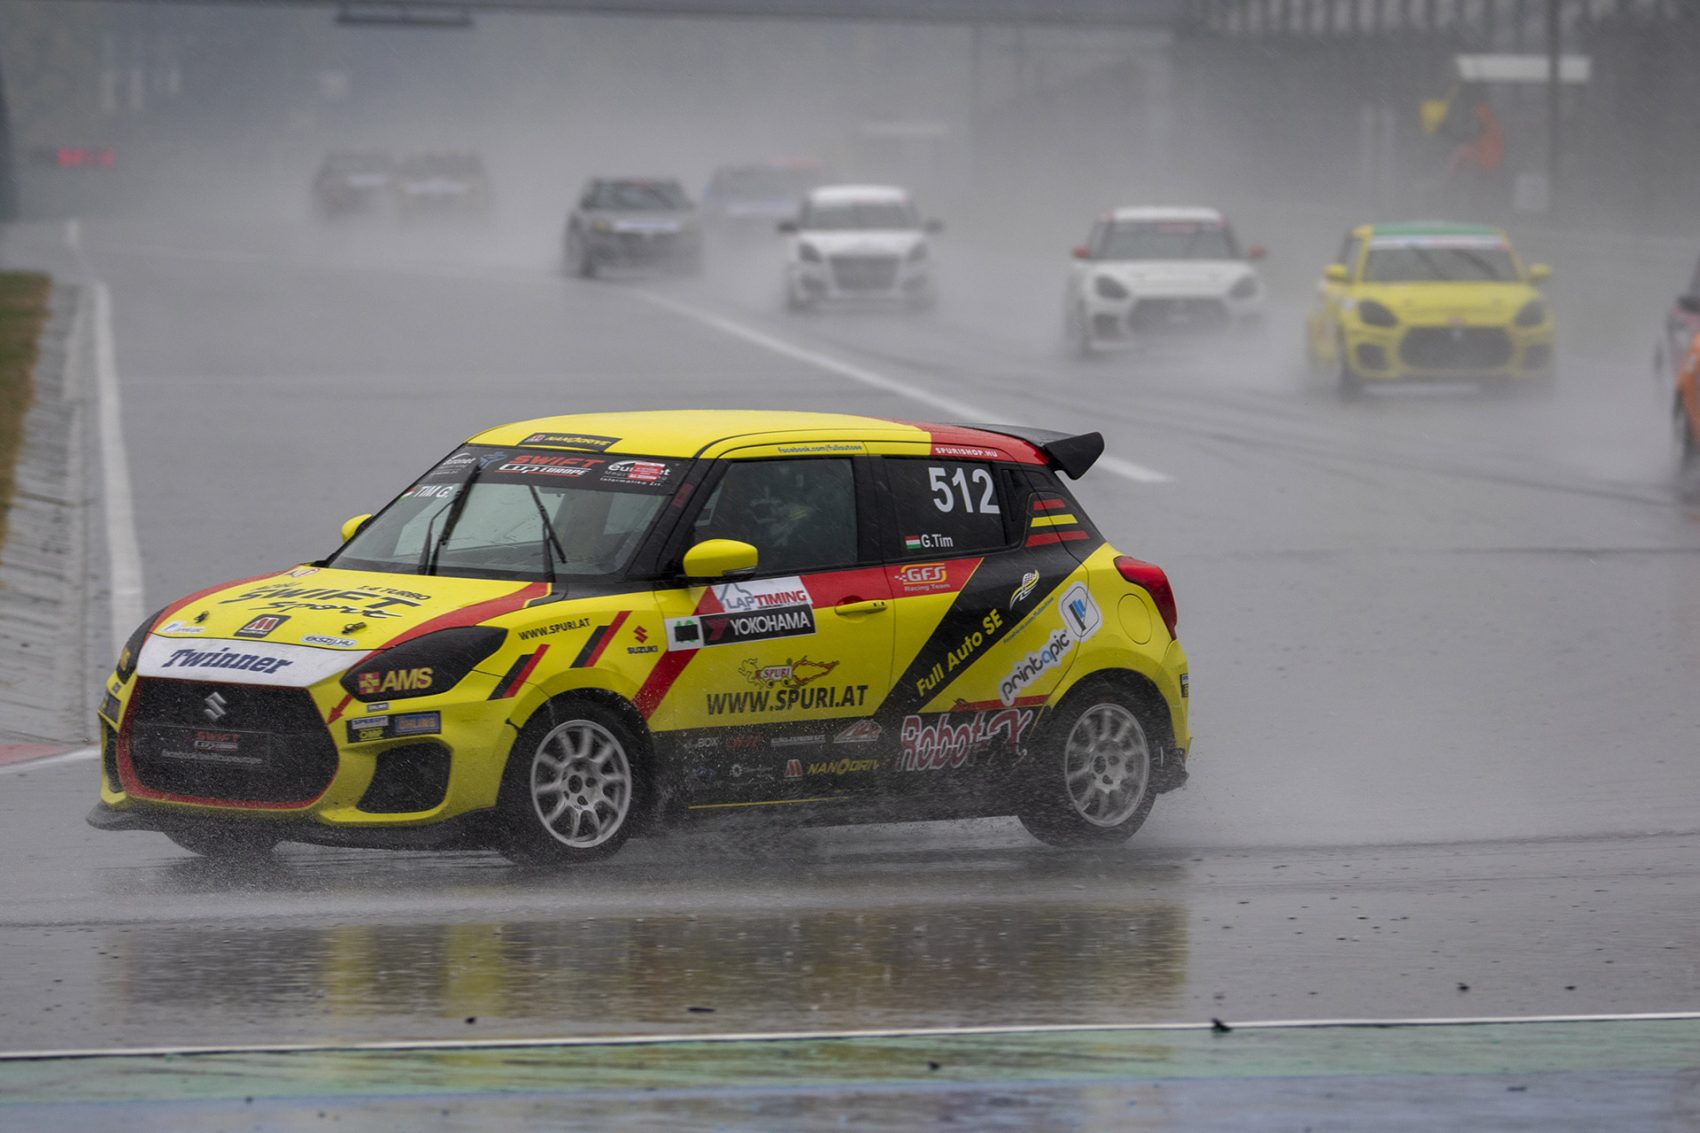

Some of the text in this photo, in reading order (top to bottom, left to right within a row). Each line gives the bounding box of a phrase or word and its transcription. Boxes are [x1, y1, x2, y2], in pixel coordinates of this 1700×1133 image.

[507, 455, 605, 468] SWIFT
[928, 467, 1001, 514] 512
[921, 534, 954, 549] G.Tim
[906, 566, 946, 583] GFS
[219, 588, 422, 609] SWIFT
[518, 618, 590, 641] WWW.SPURI.AT
[730, 611, 811, 636] YOKOHAMA
[161, 647, 293, 674] Twinner
[627, 645, 658, 655] SUZUKI
[916, 608, 1004, 697] Full Auto SE
[381, 667, 433, 692] AMS
[763, 665, 791, 680] SPURI
[706, 685, 869, 715] WWW.SPURI.AT
[808, 758, 881, 775] NANODRIV
